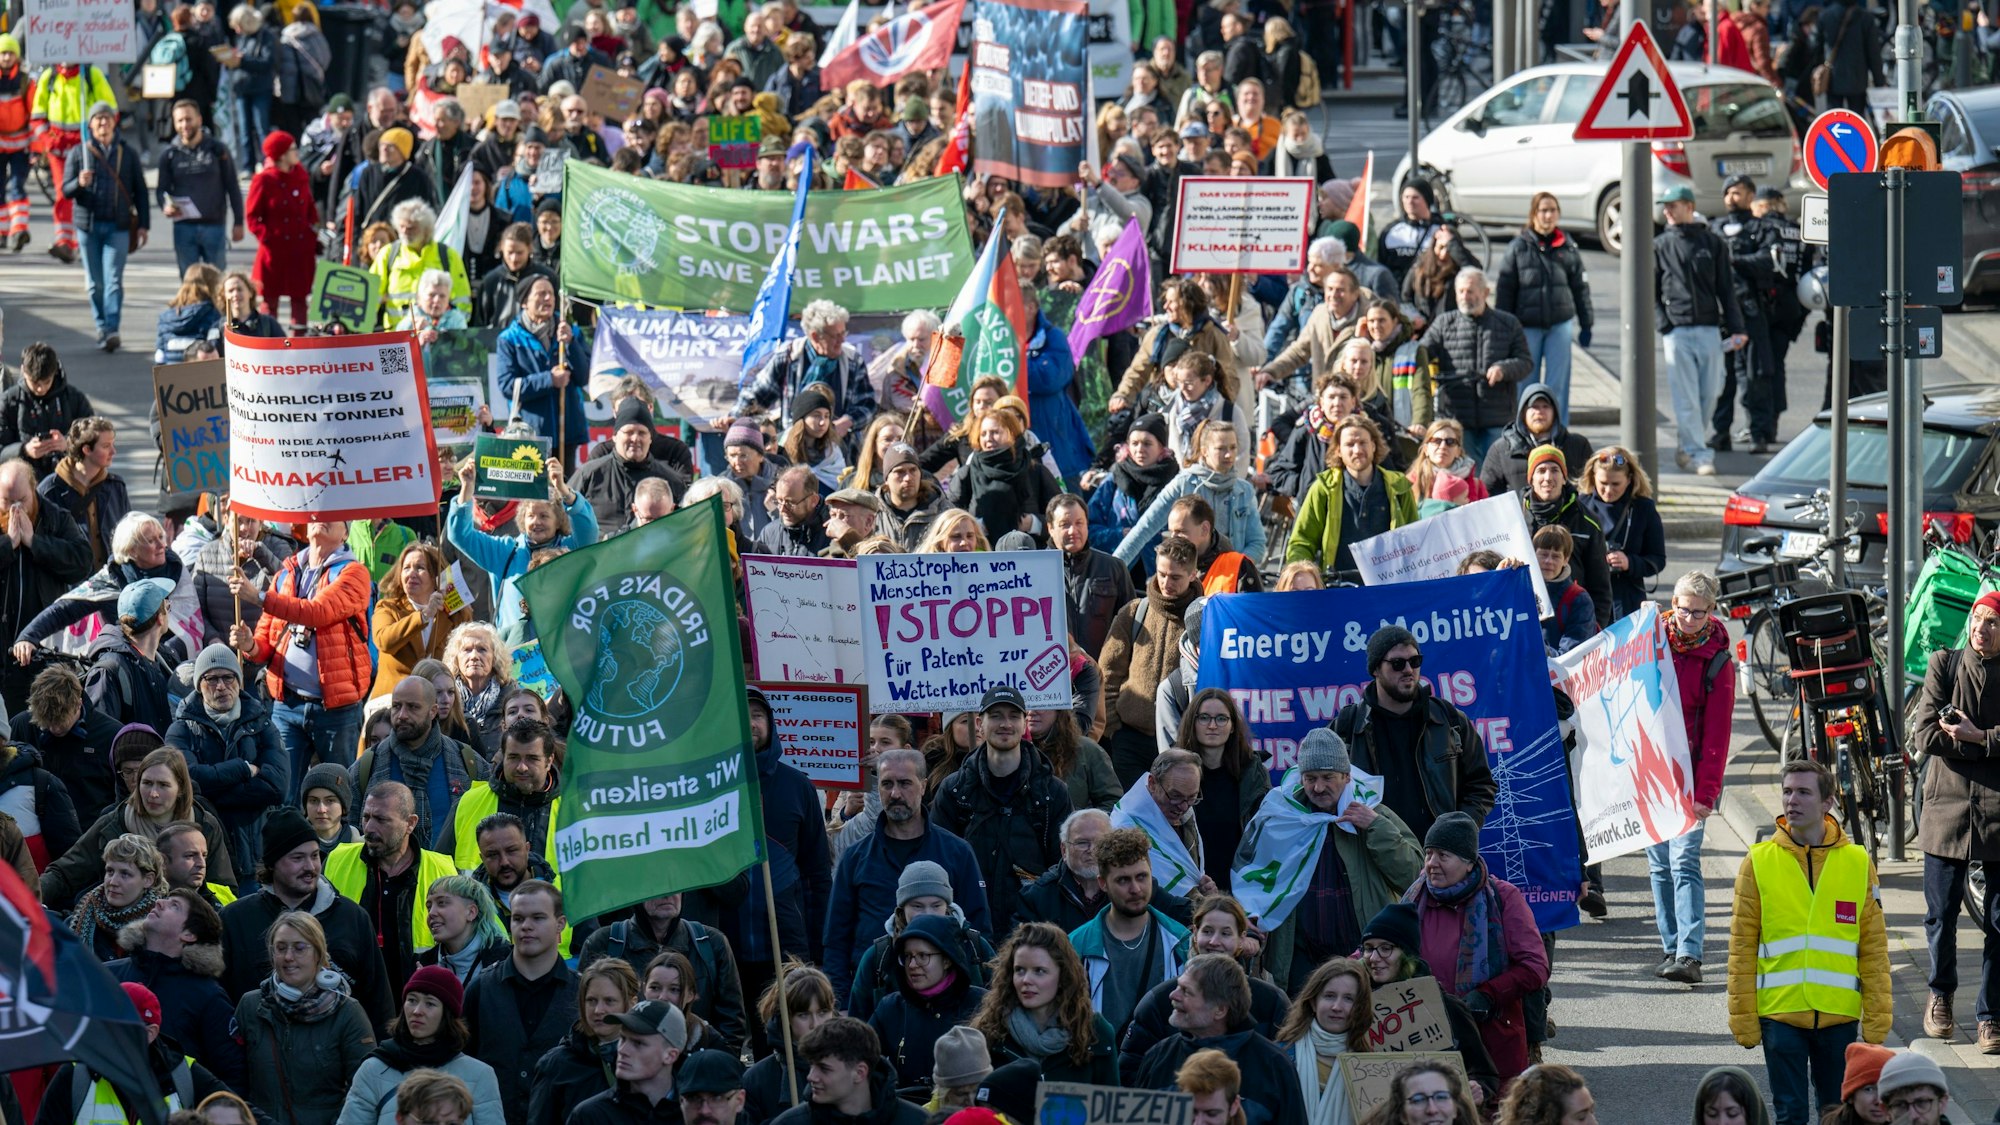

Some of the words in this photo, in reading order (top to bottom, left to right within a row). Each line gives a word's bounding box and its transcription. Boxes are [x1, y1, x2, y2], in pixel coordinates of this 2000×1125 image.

[711, 119, 756, 142] LIFE
[674, 214, 793, 254] STOP
[807, 206, 948, 254] WARS
[1188, 243, 1294, 253] KLIMAKILLER
[678, 254, 753, 284] SAVE
[833, 252, 954, 288] PLANET
[638, 331, 721, 360] FÜHRT
[230, 358, 249, 373] DAS
[250, 361, 374, 375] VERSPRÜHEN
[230, 386, 246, 402] VON
[247, 392, 333, 405] JÄHRLICH
[336, 391, 367, 404] BIS
[371, 390, 393, 401] ZU
[236, 406, 317, 423] MILLIONEN
[323, 407, 404, 422] TONNEN
[278, 438, 291, 446] IN
[293, 438, 313, 446] DIE
[316, 430, 411, 446] ATMOSPHÄRE
[281, 450, 299, 458] IST
[301, 450, 327, 459] DER
[482, 458, 501, 470] KLIMA
[171, 450, 230, 492] ÖPN
[233, 463, 414, 488] KLIMAKILLER
[489, 470, 504, 481] JOBS
[505, 470, 533, 481] SICHERN
[1371, 542, 1420, 566] Preisfrage:
[1378, 569, 1395, 581] Wo
[1397, 562, 1417, 575] wird
[1418, 556, 1432, 568] die
[1433, 547, 1467, 563] Gentech
[1468, 540, 1482, 552] 2.0
[1481, 532, 1511, 547] künftig
[749, 565, 766, 577] Das
[876, 556, 979, 582] Katastrophen
[989, 560, 1016, 573] von
[871, 580, 952, 602] Menschen
[968, 572, 1032, 601] gemacht
[846, 603, 857, 612] 20
[875, 596, 1054, 650] !STOPP!
[1219, 627, 1332, 664] Energy
[1342, 620, 1369, 652] &
[921, 646, 984, 672] Patente
[999, 649, 1028, 663] zur
[1031, 652, 1062, 684] Patent
[522, 666, 547, 682] rivers
[1229, 688, 1296, 723] THE
[1441, 670, 1478, 706] IS
[775, 718, 857, 729] RWAFFEN
[802, 734, 835, 742] ODER
[1523, 889, 1576, 903] TEIGNEN
[1836, 913, 1856, 922] ver.di
[1367, 998, 1424, 1052] NOT
